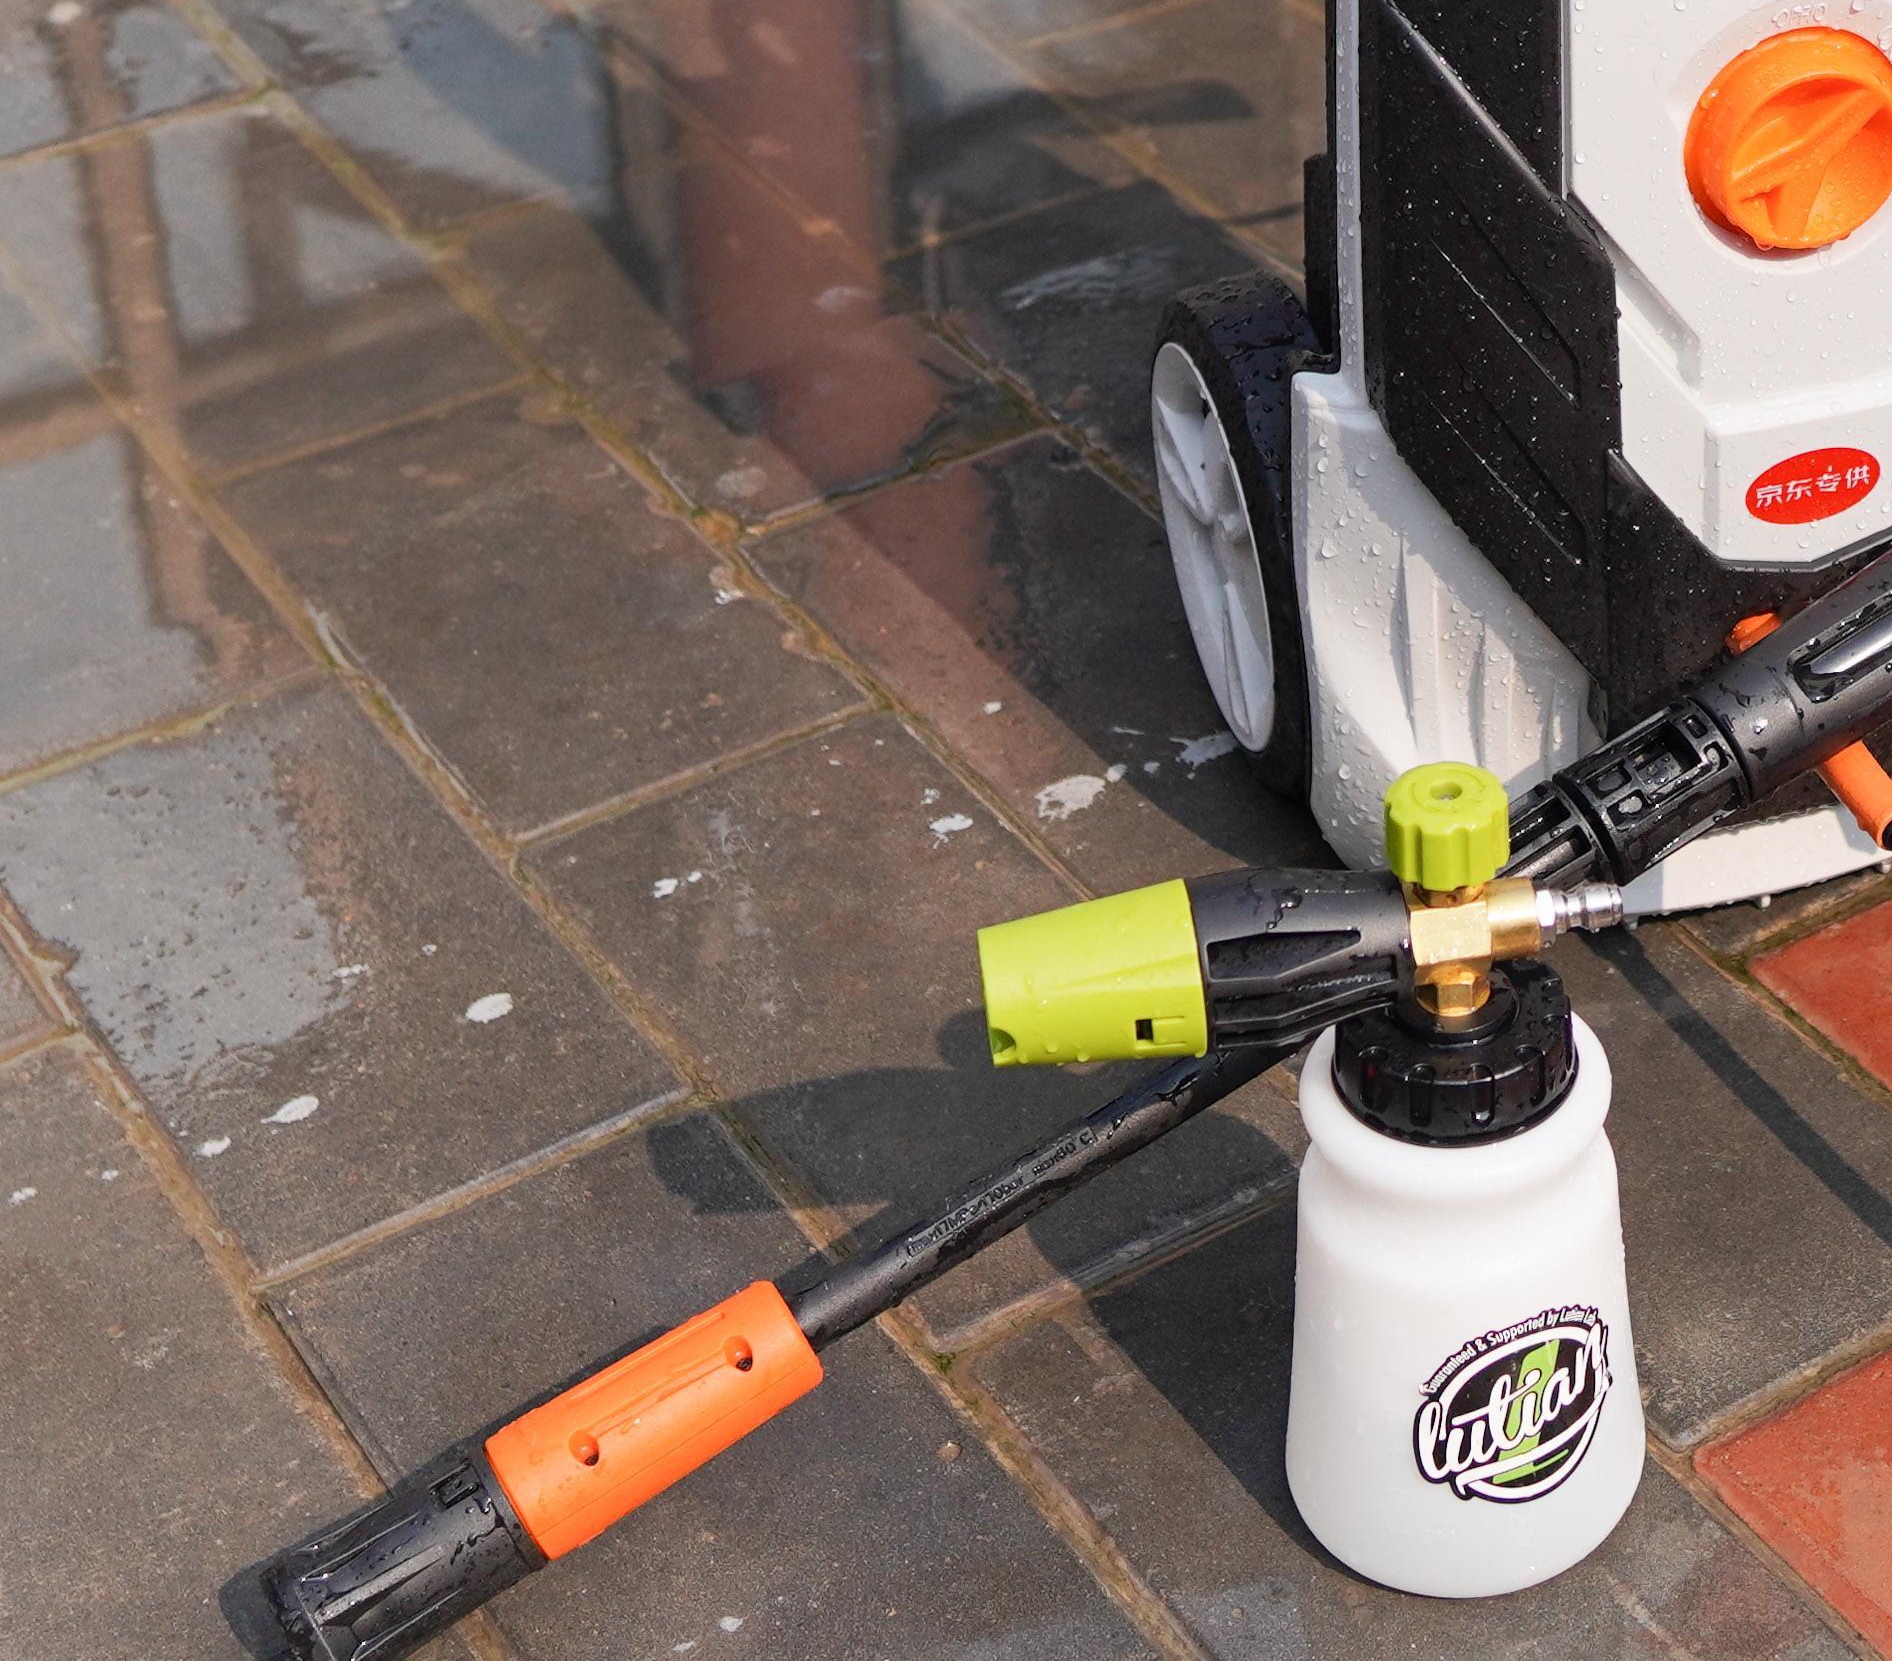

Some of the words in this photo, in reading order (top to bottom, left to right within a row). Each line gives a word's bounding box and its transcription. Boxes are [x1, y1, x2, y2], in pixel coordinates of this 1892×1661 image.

[1756, 464, 1871, 509] 京东专供
[1423, 1342, 1478, 1394] Guaranteed
[1474, 1338, 1489, 1352] &
[1486, 1311, 1546, 1347] Supported
[1546, 1310, 1561, 1327] by
